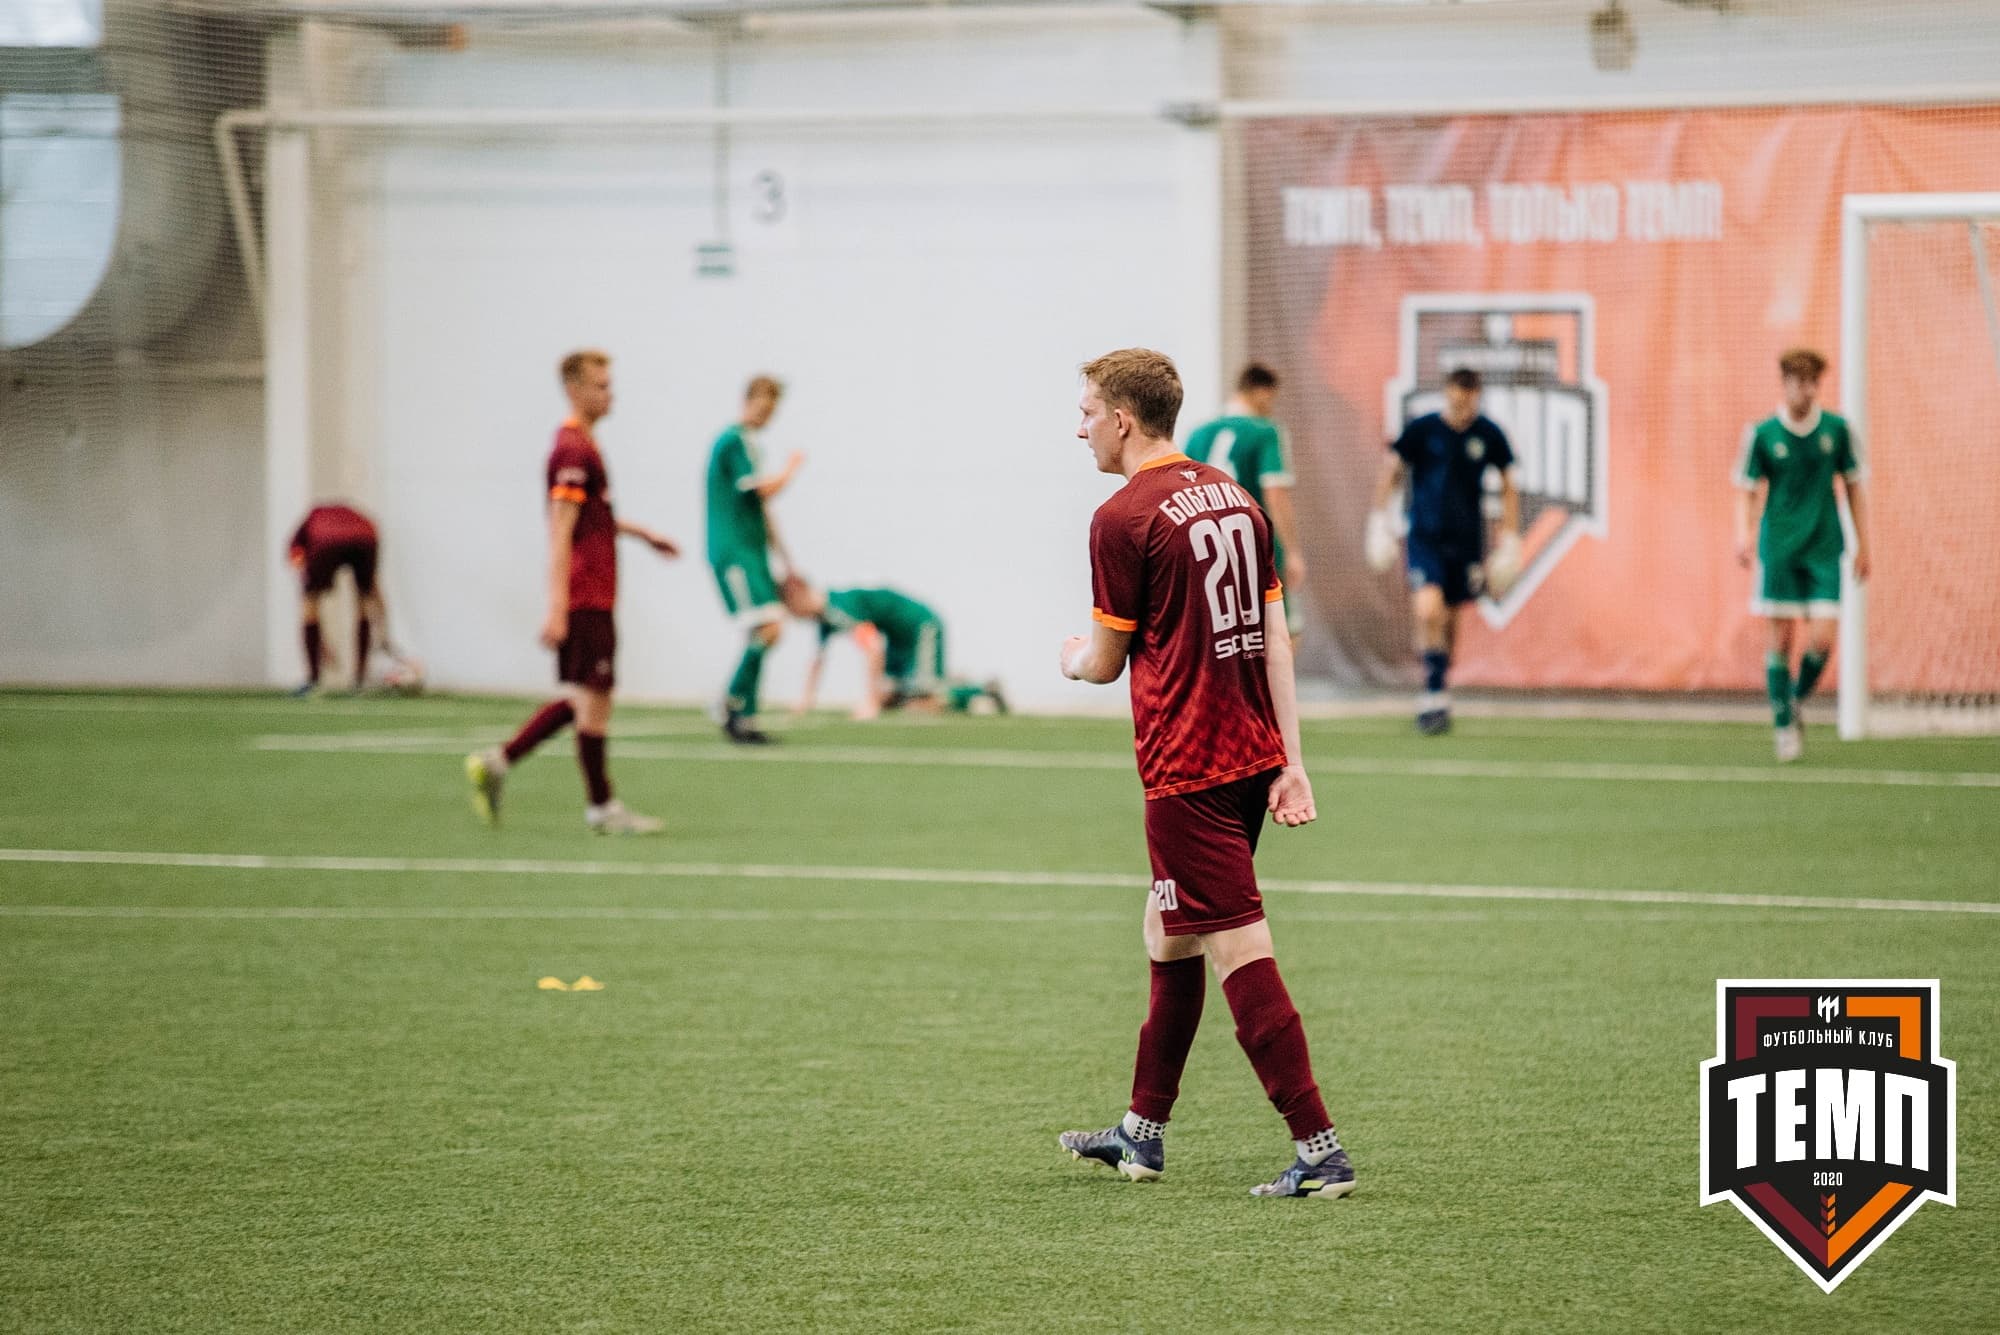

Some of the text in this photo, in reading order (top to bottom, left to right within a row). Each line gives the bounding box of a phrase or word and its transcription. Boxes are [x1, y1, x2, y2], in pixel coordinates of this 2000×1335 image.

[753, 168, 787, 225] 3
[1189, 513, 1260, 634] 20
[1155, 879, 1178, 911] 20
